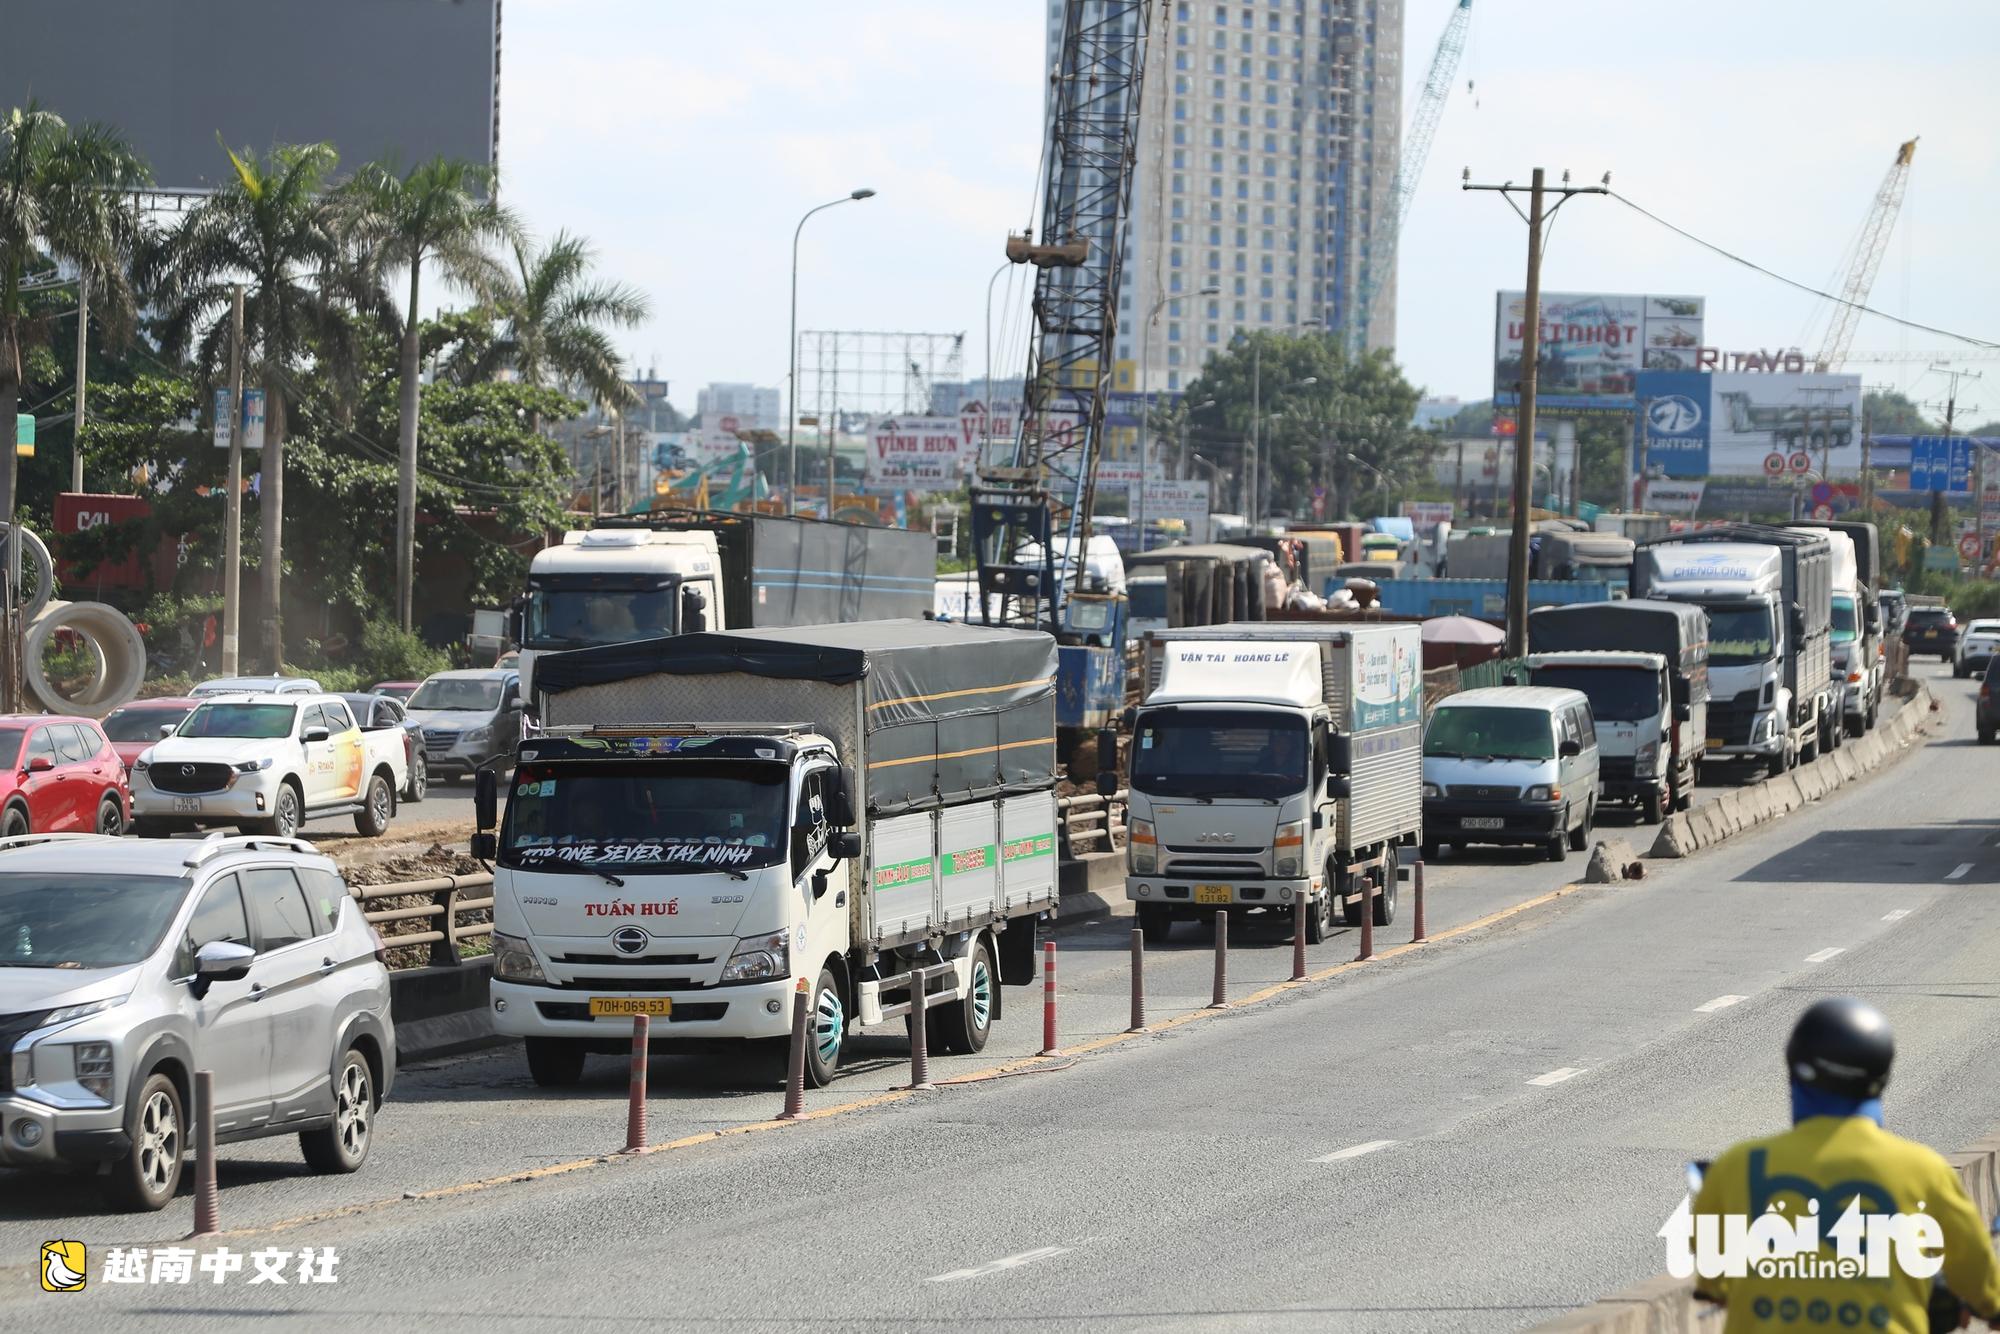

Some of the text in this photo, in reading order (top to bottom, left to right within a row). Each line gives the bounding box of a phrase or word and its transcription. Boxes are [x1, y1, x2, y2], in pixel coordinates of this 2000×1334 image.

[1673, 567, 1747, 577] CHENGLONG
[557, 844, 600, 863] ONE
[596, 843, 666, 863] SEVER
[664, 843, 704, 863] TAY
[699, 845, 753, 865] NINH
[522, 896, 558, 906] HINO
[711, 894, 745, 905] 300
[585, 897, 680, 917] TUẤN HUẾ
[595, 1000, 665, 1014] 70H-069.53
